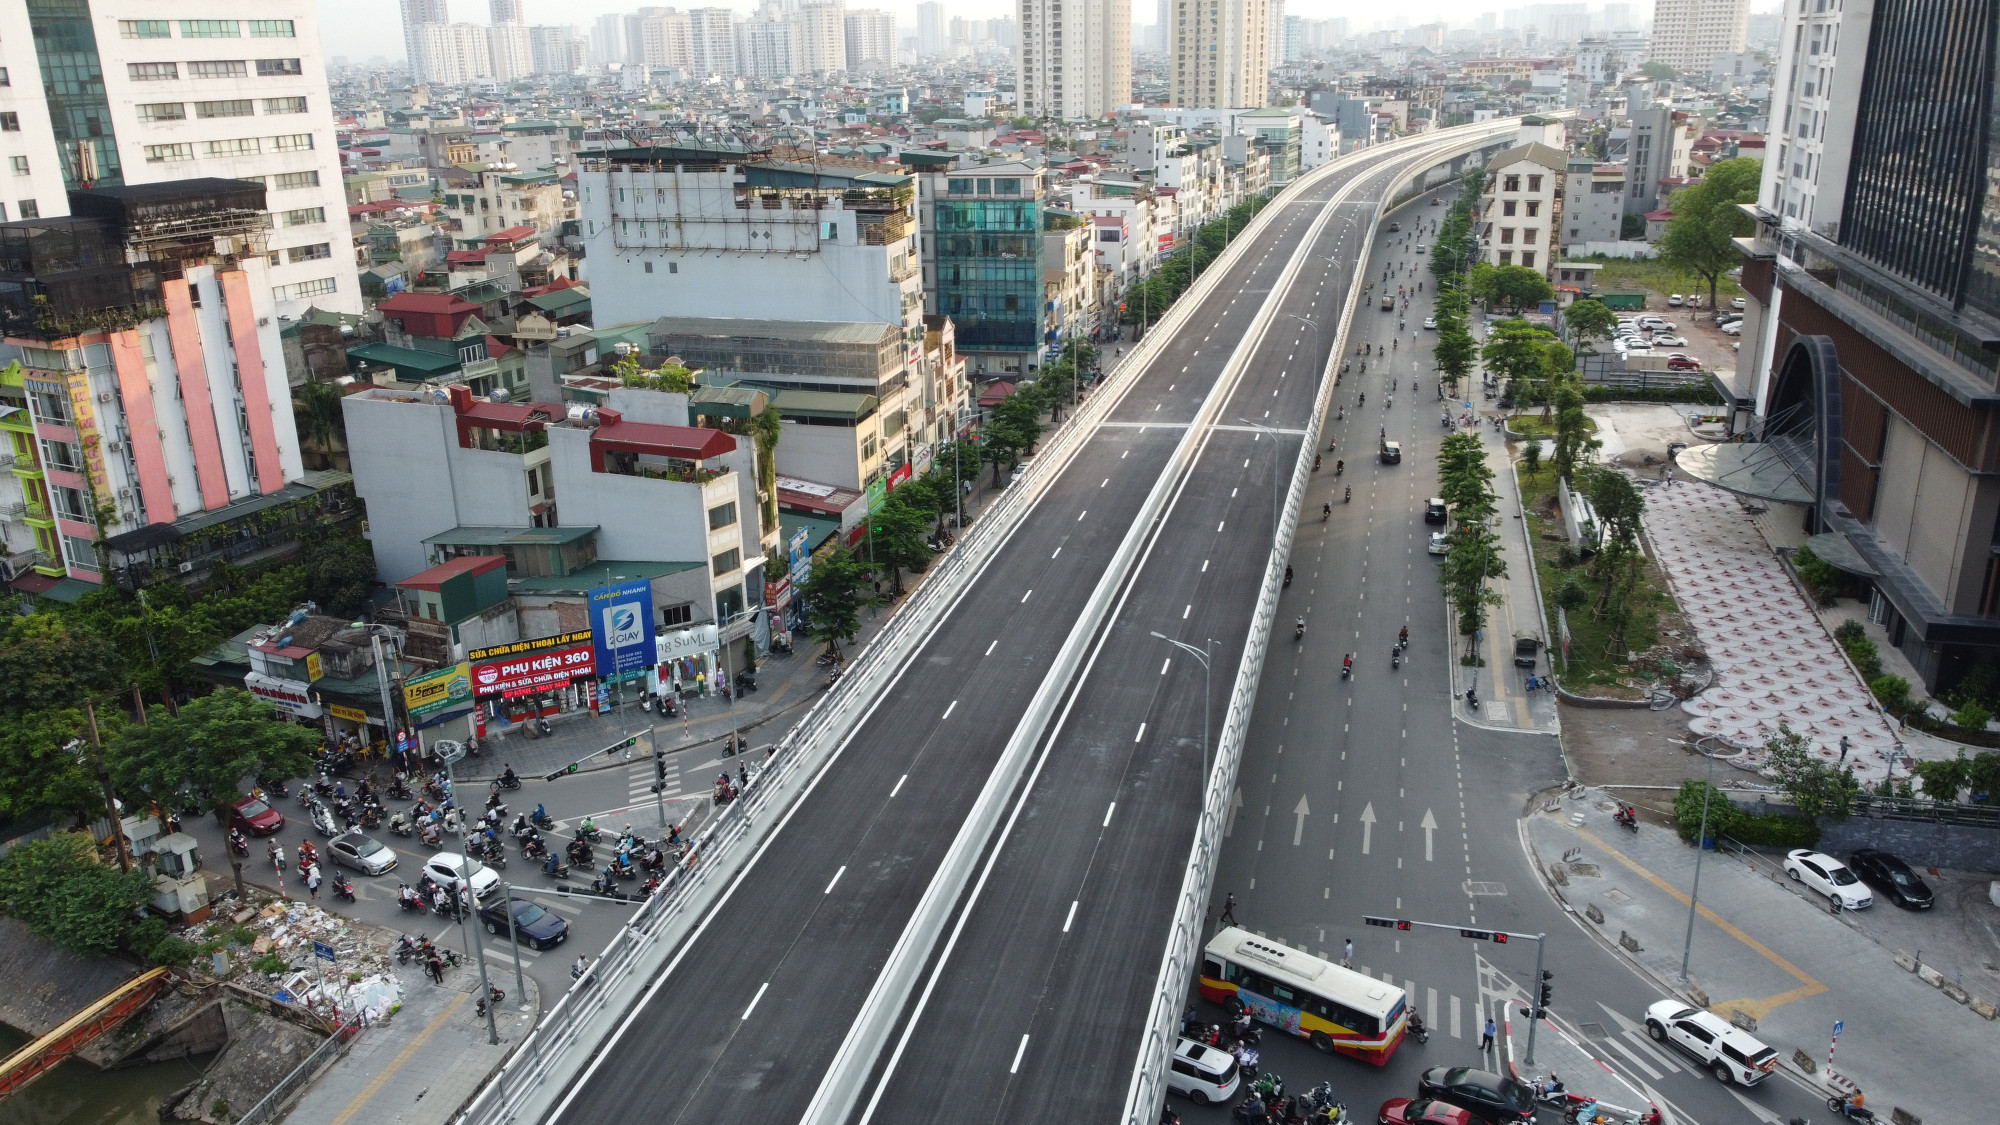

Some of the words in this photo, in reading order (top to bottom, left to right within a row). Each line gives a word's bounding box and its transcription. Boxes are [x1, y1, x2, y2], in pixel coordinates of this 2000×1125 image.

[25, 380, 66, 394] HOTEL
[622, 586, 646, 595] NHANH
[470, 649, 487, 660] SỬA
[488, 645, 510, 656] CHỮA
[512, 642, 530, 653] ĐIỆN
[532, 638, 555, 649] THOẠI
[557, 634, 570, 644] LẤY
[572, 630, 592, 641] NGAY
[502, 662, 529, 675] PHỤ
[532, 656, 562, 670] KIỆN
[565, 651, 590, 664] 360
[479, 686, 494, 694] PHỤ
[495, 682, 511, 691] KIỆN
[518, 677, 532, 686] SỬA
[533, 673, 553, 683] CHỮA
[554, 670, 570, 680] ĐIỆN
[571, 666, 592, 676] THOẠI
[409, 687, 422, 698] 15
[535, 683, 554, 693] THAY
